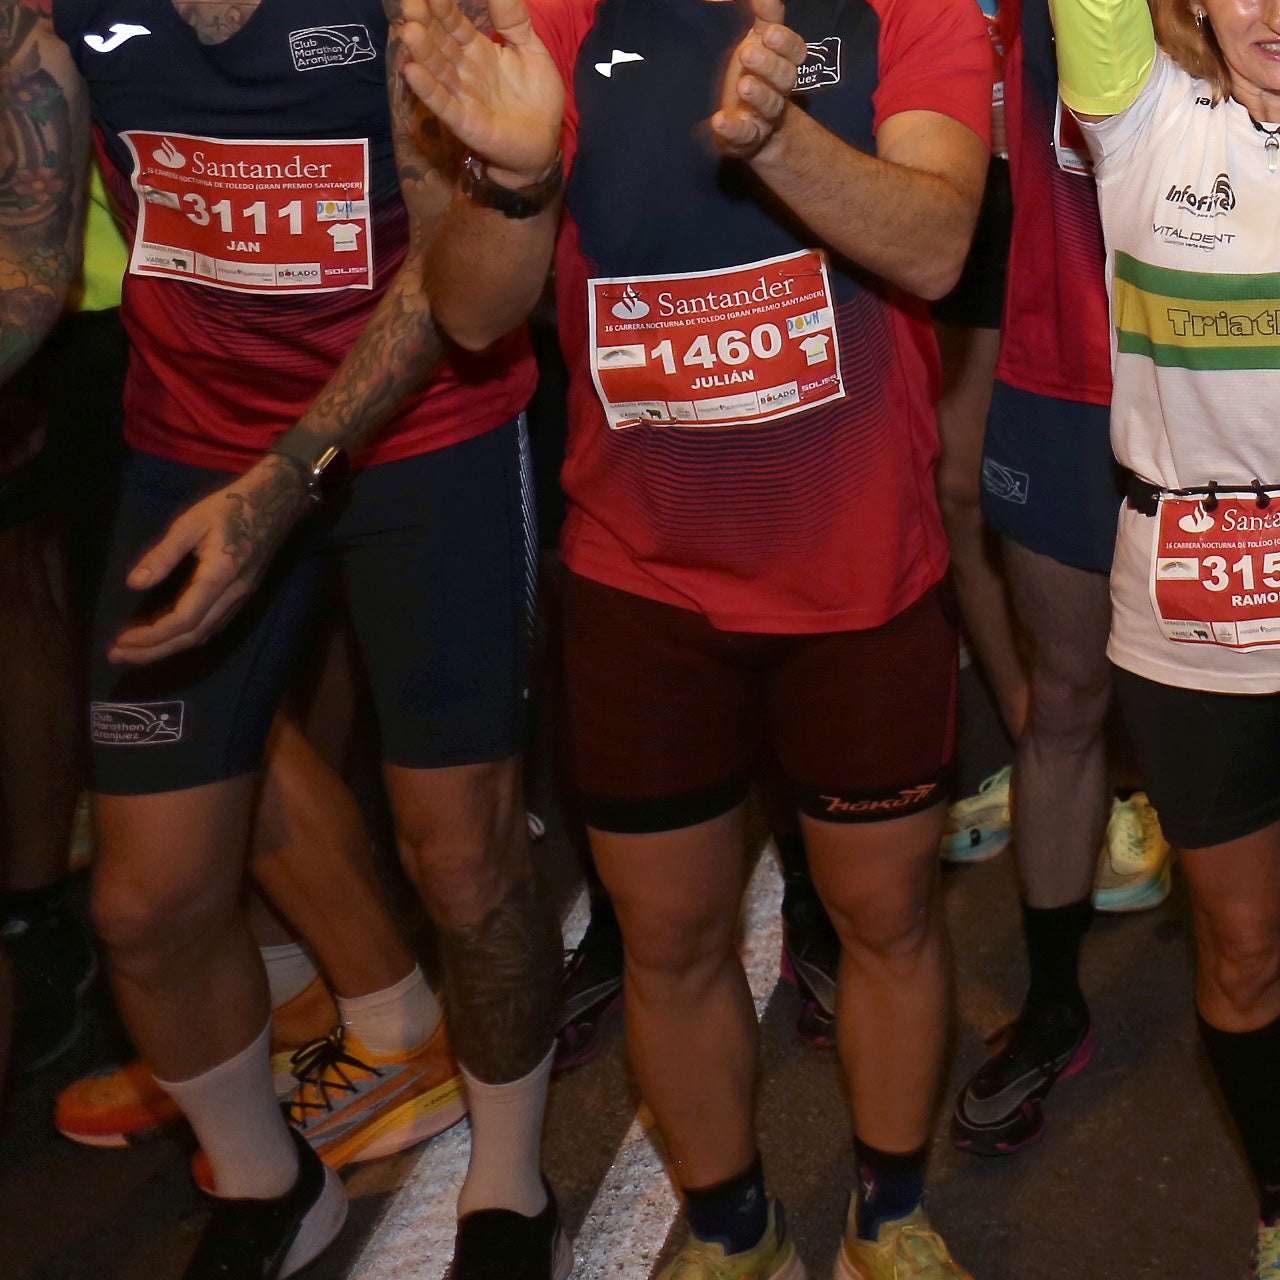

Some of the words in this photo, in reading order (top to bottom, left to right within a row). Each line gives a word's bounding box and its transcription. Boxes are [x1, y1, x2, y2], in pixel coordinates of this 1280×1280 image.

[293, 39, 317, 50] Club
[294, 46, 342, 58] Marathon
[298, 54, 344, 67] Aranjuez
[192, 151, 332, 179] Santander
[183, 193, 303, 235] 3111
[1152, 223, 1236, 245] VITALDENT
[226, 241, 261, 253] JAN
[279, 269, 318, 277] BOLADO
[324, 267, 367, 276] SOLISS
[658, 276, 794, 317] Santander
[605, 324, 613, 332] 16
[614, 322, 645, 332] CARRERA
[645, 319, 684, 329] NOCTURNA
[696, 314, 726, 324] TOLEDO
[727, 309, 750, 321] (GRAN
[752, 302, 781, 315] PREMIO
[781, 289, 824, 307] SANTANDER)
[651, 322, 782, 375] 1460
[691, 369, 755, 390] JULIÁN
[1201, 542, 1236, 550] NOCTURNA
[1247, 539, 1273, 548] TOLEDO
[94, 722, 144, 731] Marathon
